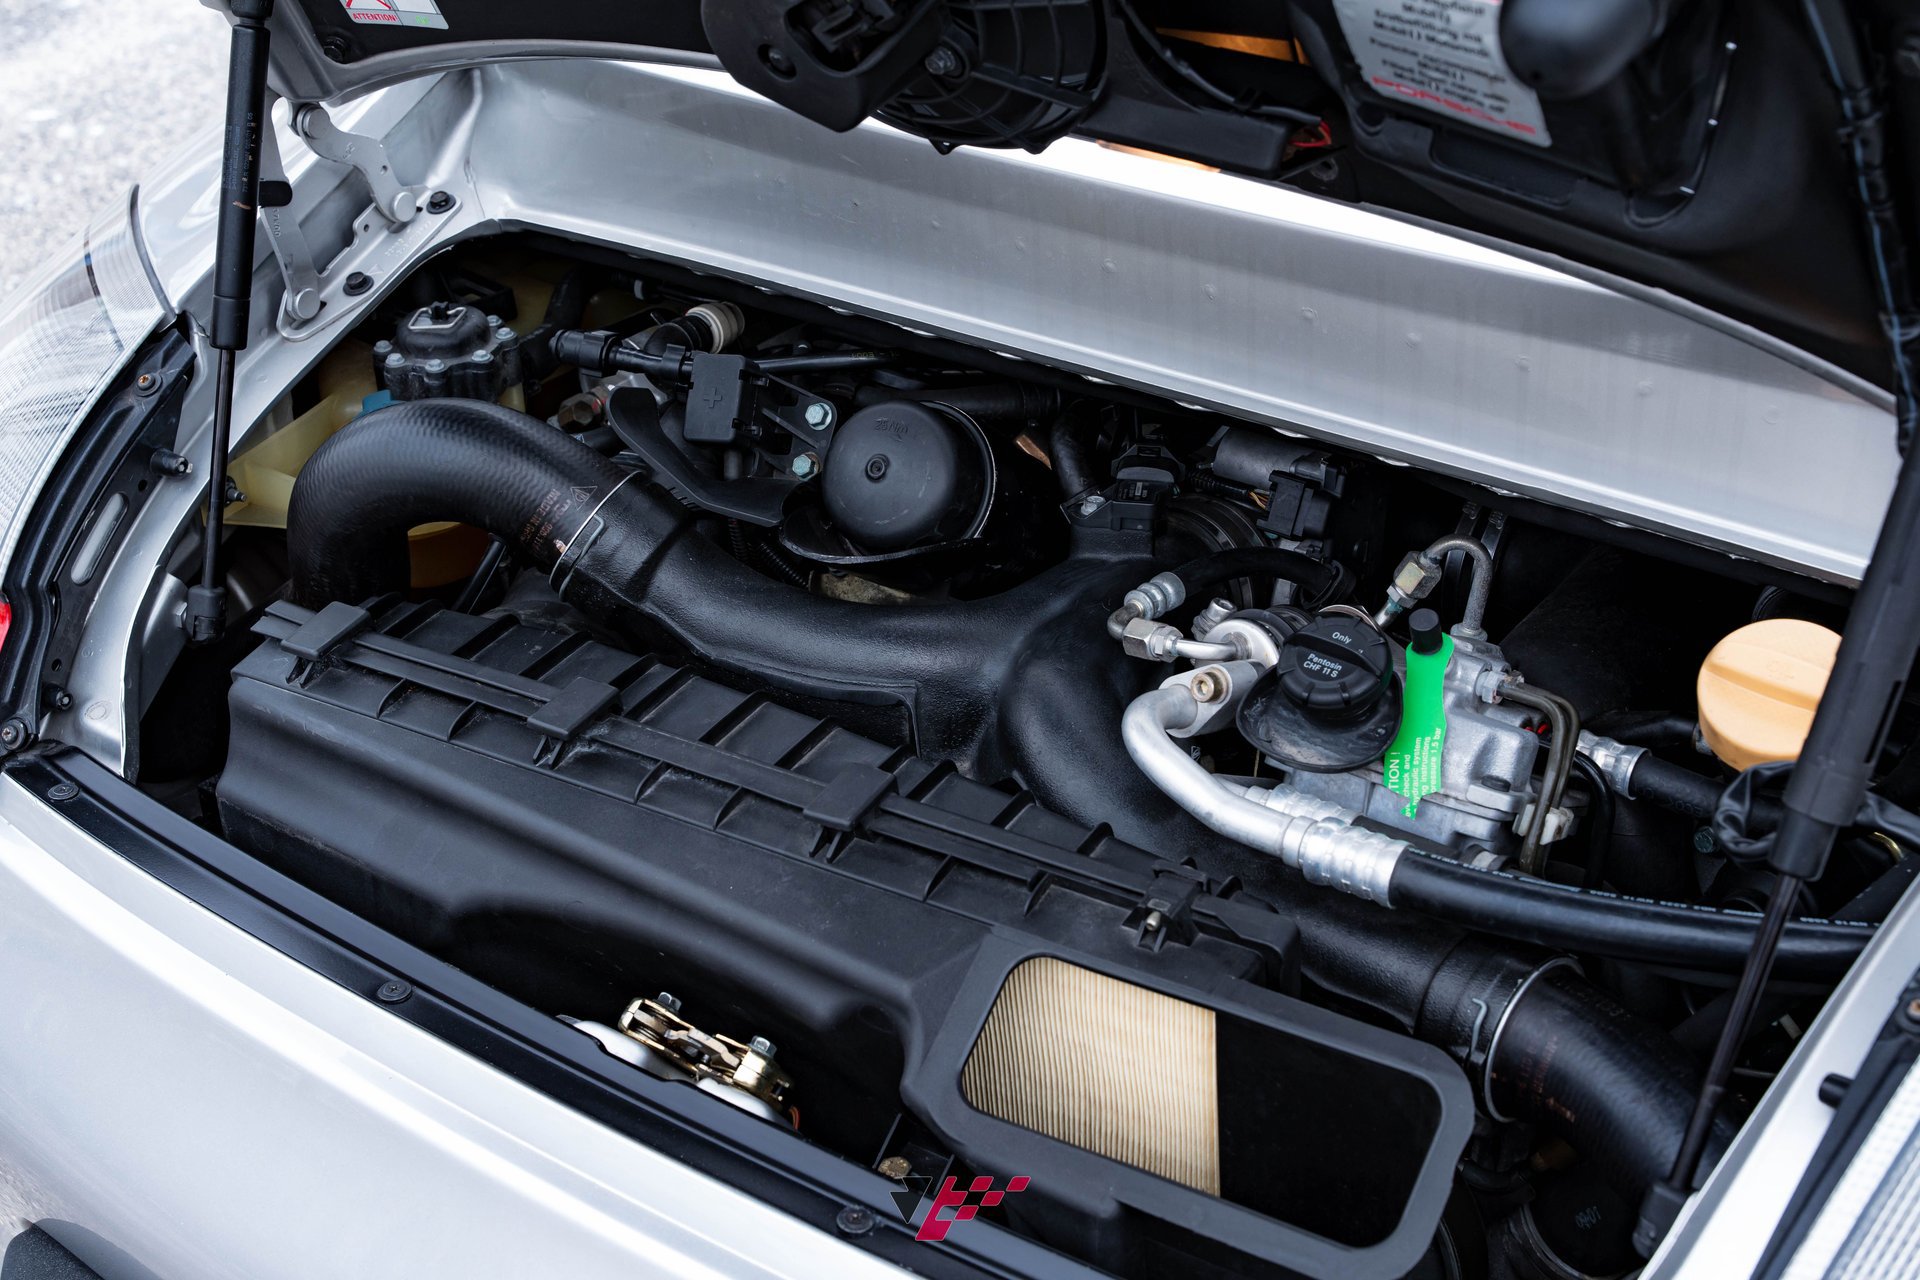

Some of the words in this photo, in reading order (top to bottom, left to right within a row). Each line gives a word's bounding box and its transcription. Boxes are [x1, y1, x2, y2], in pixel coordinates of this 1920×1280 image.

[1332, 631, 1352, 644] Only
[1303, 660, 1321, 671] CHF
[1322, 667, 1331, 675] 11
[1330, 670, 1338, 678] S
[1307, 653, 1342, 671] Pentosin
[1434, 727, 1442, 740] bar
[1413, 737, 1422, 765] system
[1421, 736, 1431, 782] instructions
[1388, 759, 1400, 794] TION
